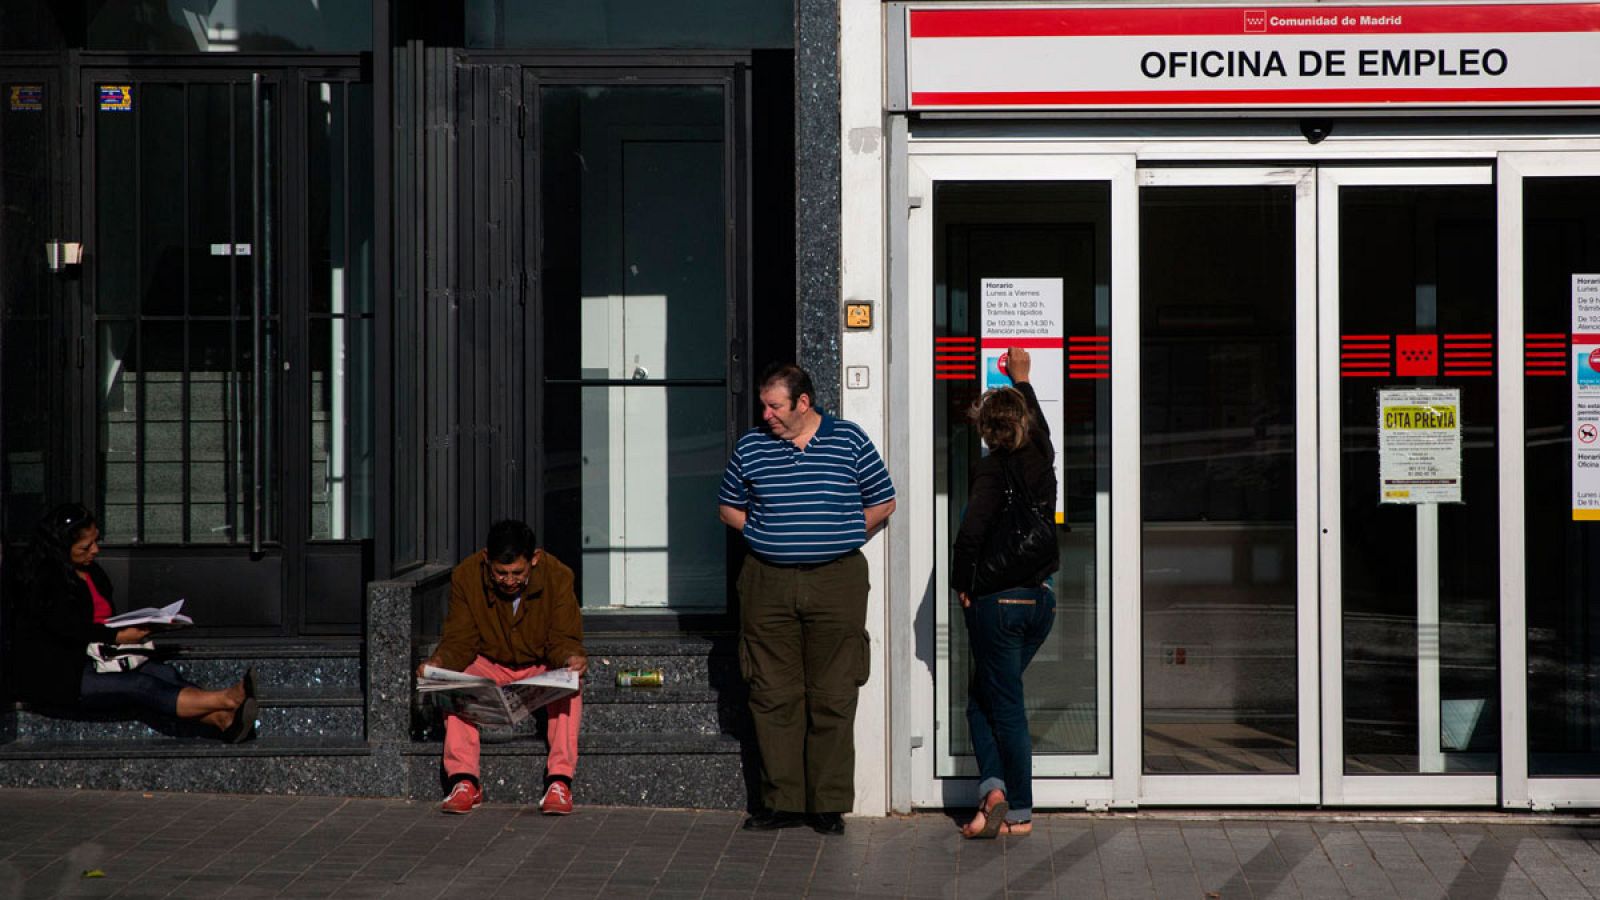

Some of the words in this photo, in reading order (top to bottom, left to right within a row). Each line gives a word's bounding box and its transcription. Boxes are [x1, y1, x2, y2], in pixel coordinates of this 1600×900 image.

[1269, 16, 1338, 26] Comunidad
[1341, 16, 1357, 26] de
[1359, 15, 1402, 25] Madrid
[1140, 50, 1288, 78] OFICINA
[1299, 50, 1346, 77] DE
[1358, 48, 1508, 77] EMPLEO
[1385, 412, 1411, 429] CITA
[1414, 411, 1456, 429] PREVIA
[1577, 460, 1599, 468] Oficina
